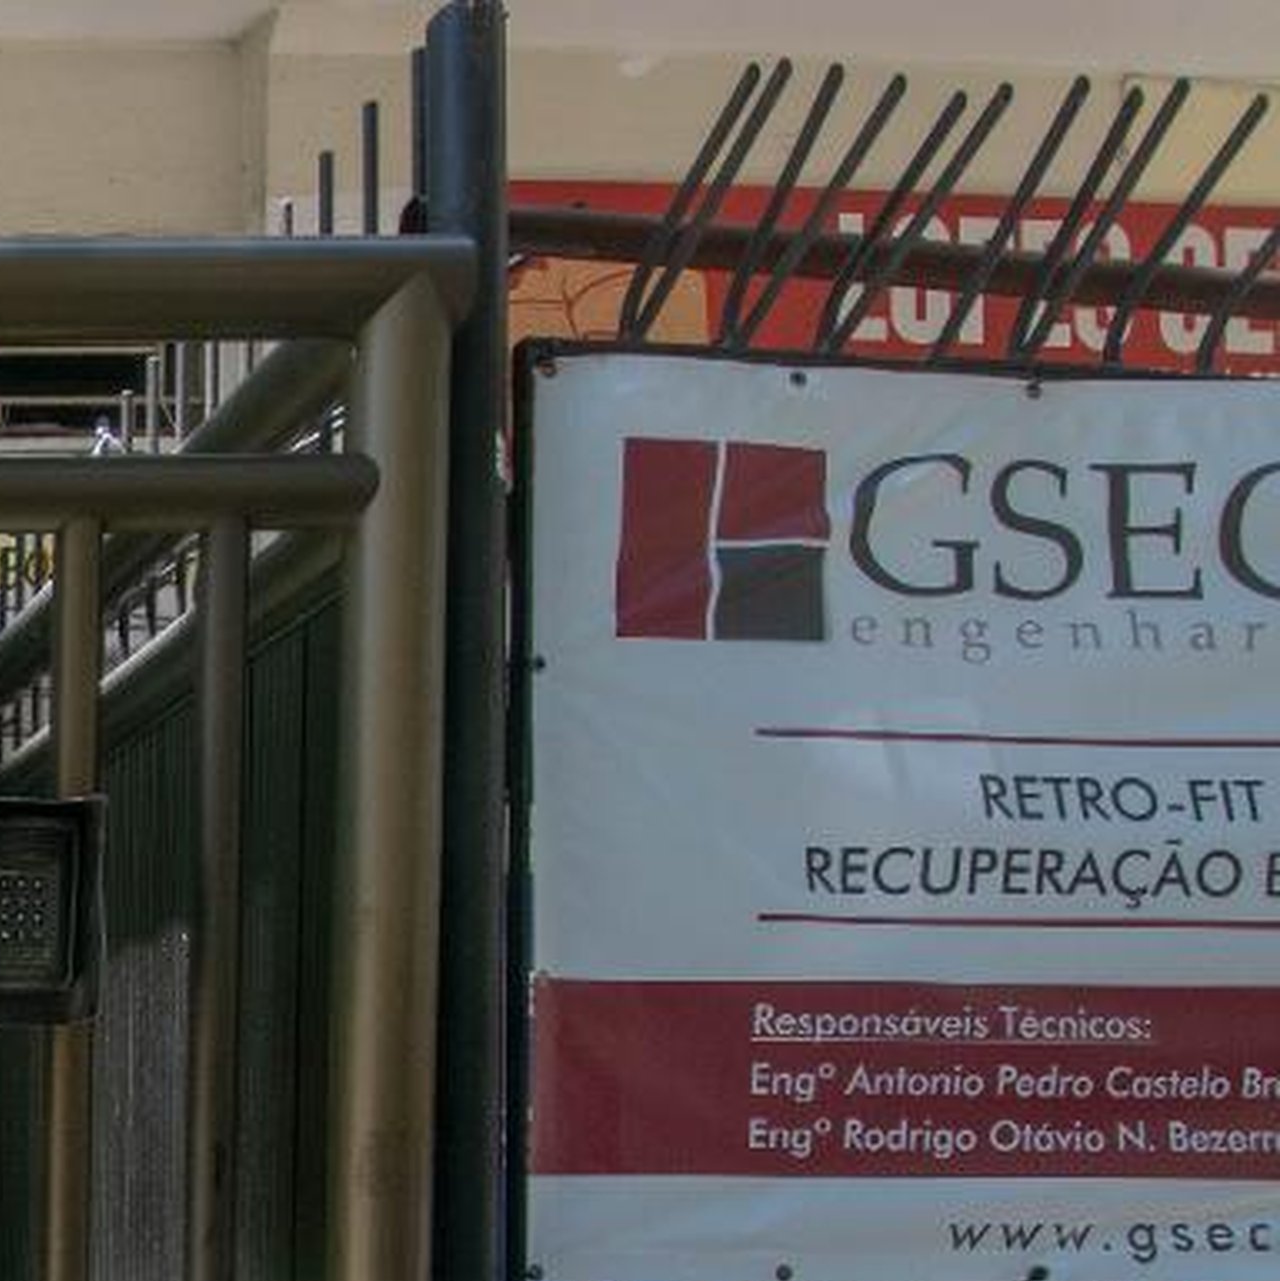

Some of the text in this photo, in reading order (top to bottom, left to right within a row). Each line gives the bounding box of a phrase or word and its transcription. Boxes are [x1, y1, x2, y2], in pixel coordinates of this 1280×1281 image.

[981, 774, 1265, 822] RETRO-FIT
[806, 838, 1243, 908] RECUPERAÇÃO
[752, 1003, 989, 1042] Responsáveis
[844, 1065, 985, 1096] Antonio
[997, 1065, 1094, 1097] Pedro
[1105, 1065, 1230, 1098] Castelo
[843, 1119, 978, 1159] Rodrigo
[990, 1120, 1105, 1152] Otávio
[1118, 1120, 1155, 1151] N.
[1168, 1121, 1280, 1152] Bezerr
